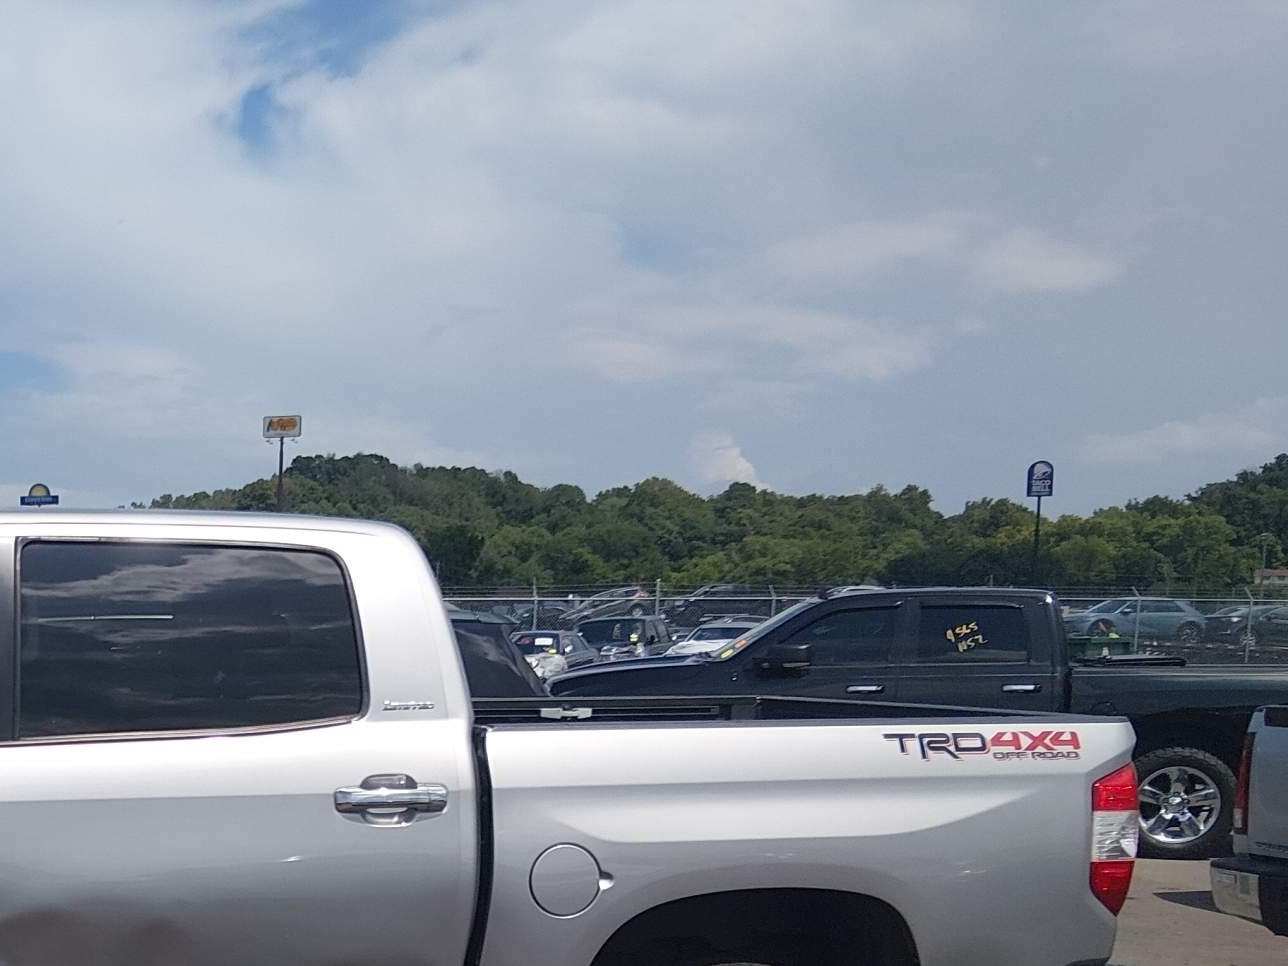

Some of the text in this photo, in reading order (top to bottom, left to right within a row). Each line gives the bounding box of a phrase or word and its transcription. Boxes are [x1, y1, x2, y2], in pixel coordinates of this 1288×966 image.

[882, 731, 1081, 761] TRD 4X4
[992, 751, 1079, 760] OFF ROAD
